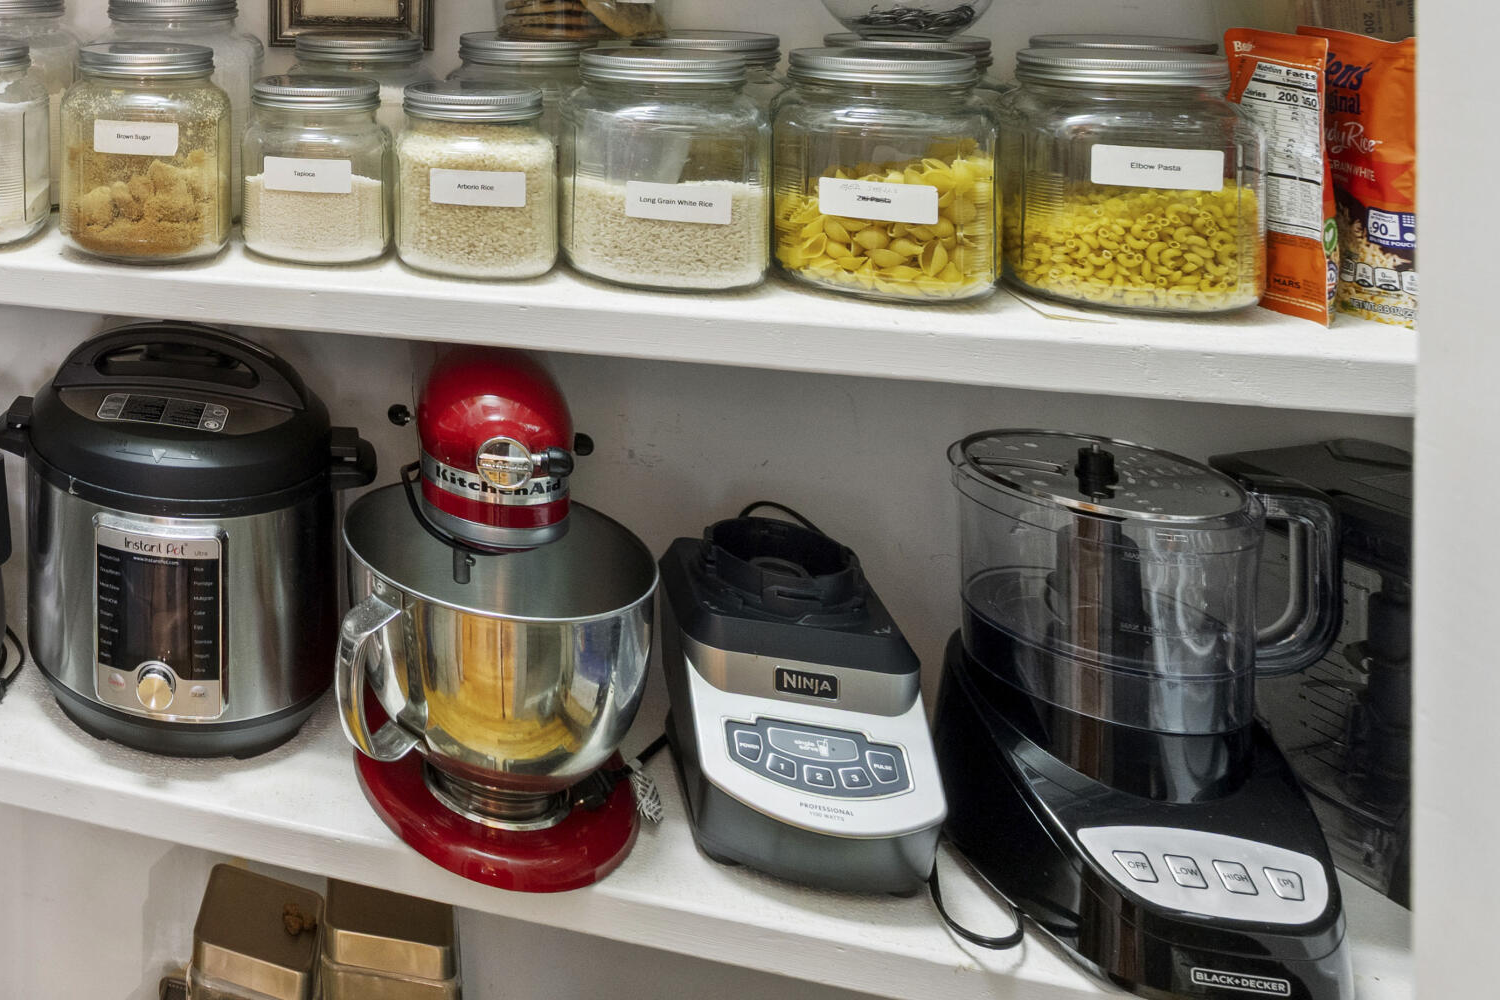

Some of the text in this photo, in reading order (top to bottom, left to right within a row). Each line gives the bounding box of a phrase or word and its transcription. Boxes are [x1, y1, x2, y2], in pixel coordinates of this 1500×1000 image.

[1285, 69, 1317, 80] Facts
[1278, 91, 1298, 103] 200
[1130, 161, 1181, 172] Elbow Pasta
[293, 170, 316, 178] Tapioca
[1354, 165, 1376, 181] WHITE
[639, 196, 713, 208] Long Grain White Rice
[1372, 221, 1388, 236] 90
[1273, 277, 1300, 289] MARS
[124, 537, 185, 556] Instant Pot
[783, 671, 833, 694] NINJA
[739, 742, 760, 750] POWER
[873, 763, 893, 771] PULSE
[815, 773, 823, 781] 2
[851, 774, 860, 782] 3
[799, 802, 854, 817] PROFESSIONAL
[824, 813, 845, 822] WATTS
[1127, 861, 1148, 870] OFF
[1173, 866, 1199, 877] LOW
[1222, 872, 1248, 883] HIGH
[1195, 971, 1287, 992] BLACK+DECKER
